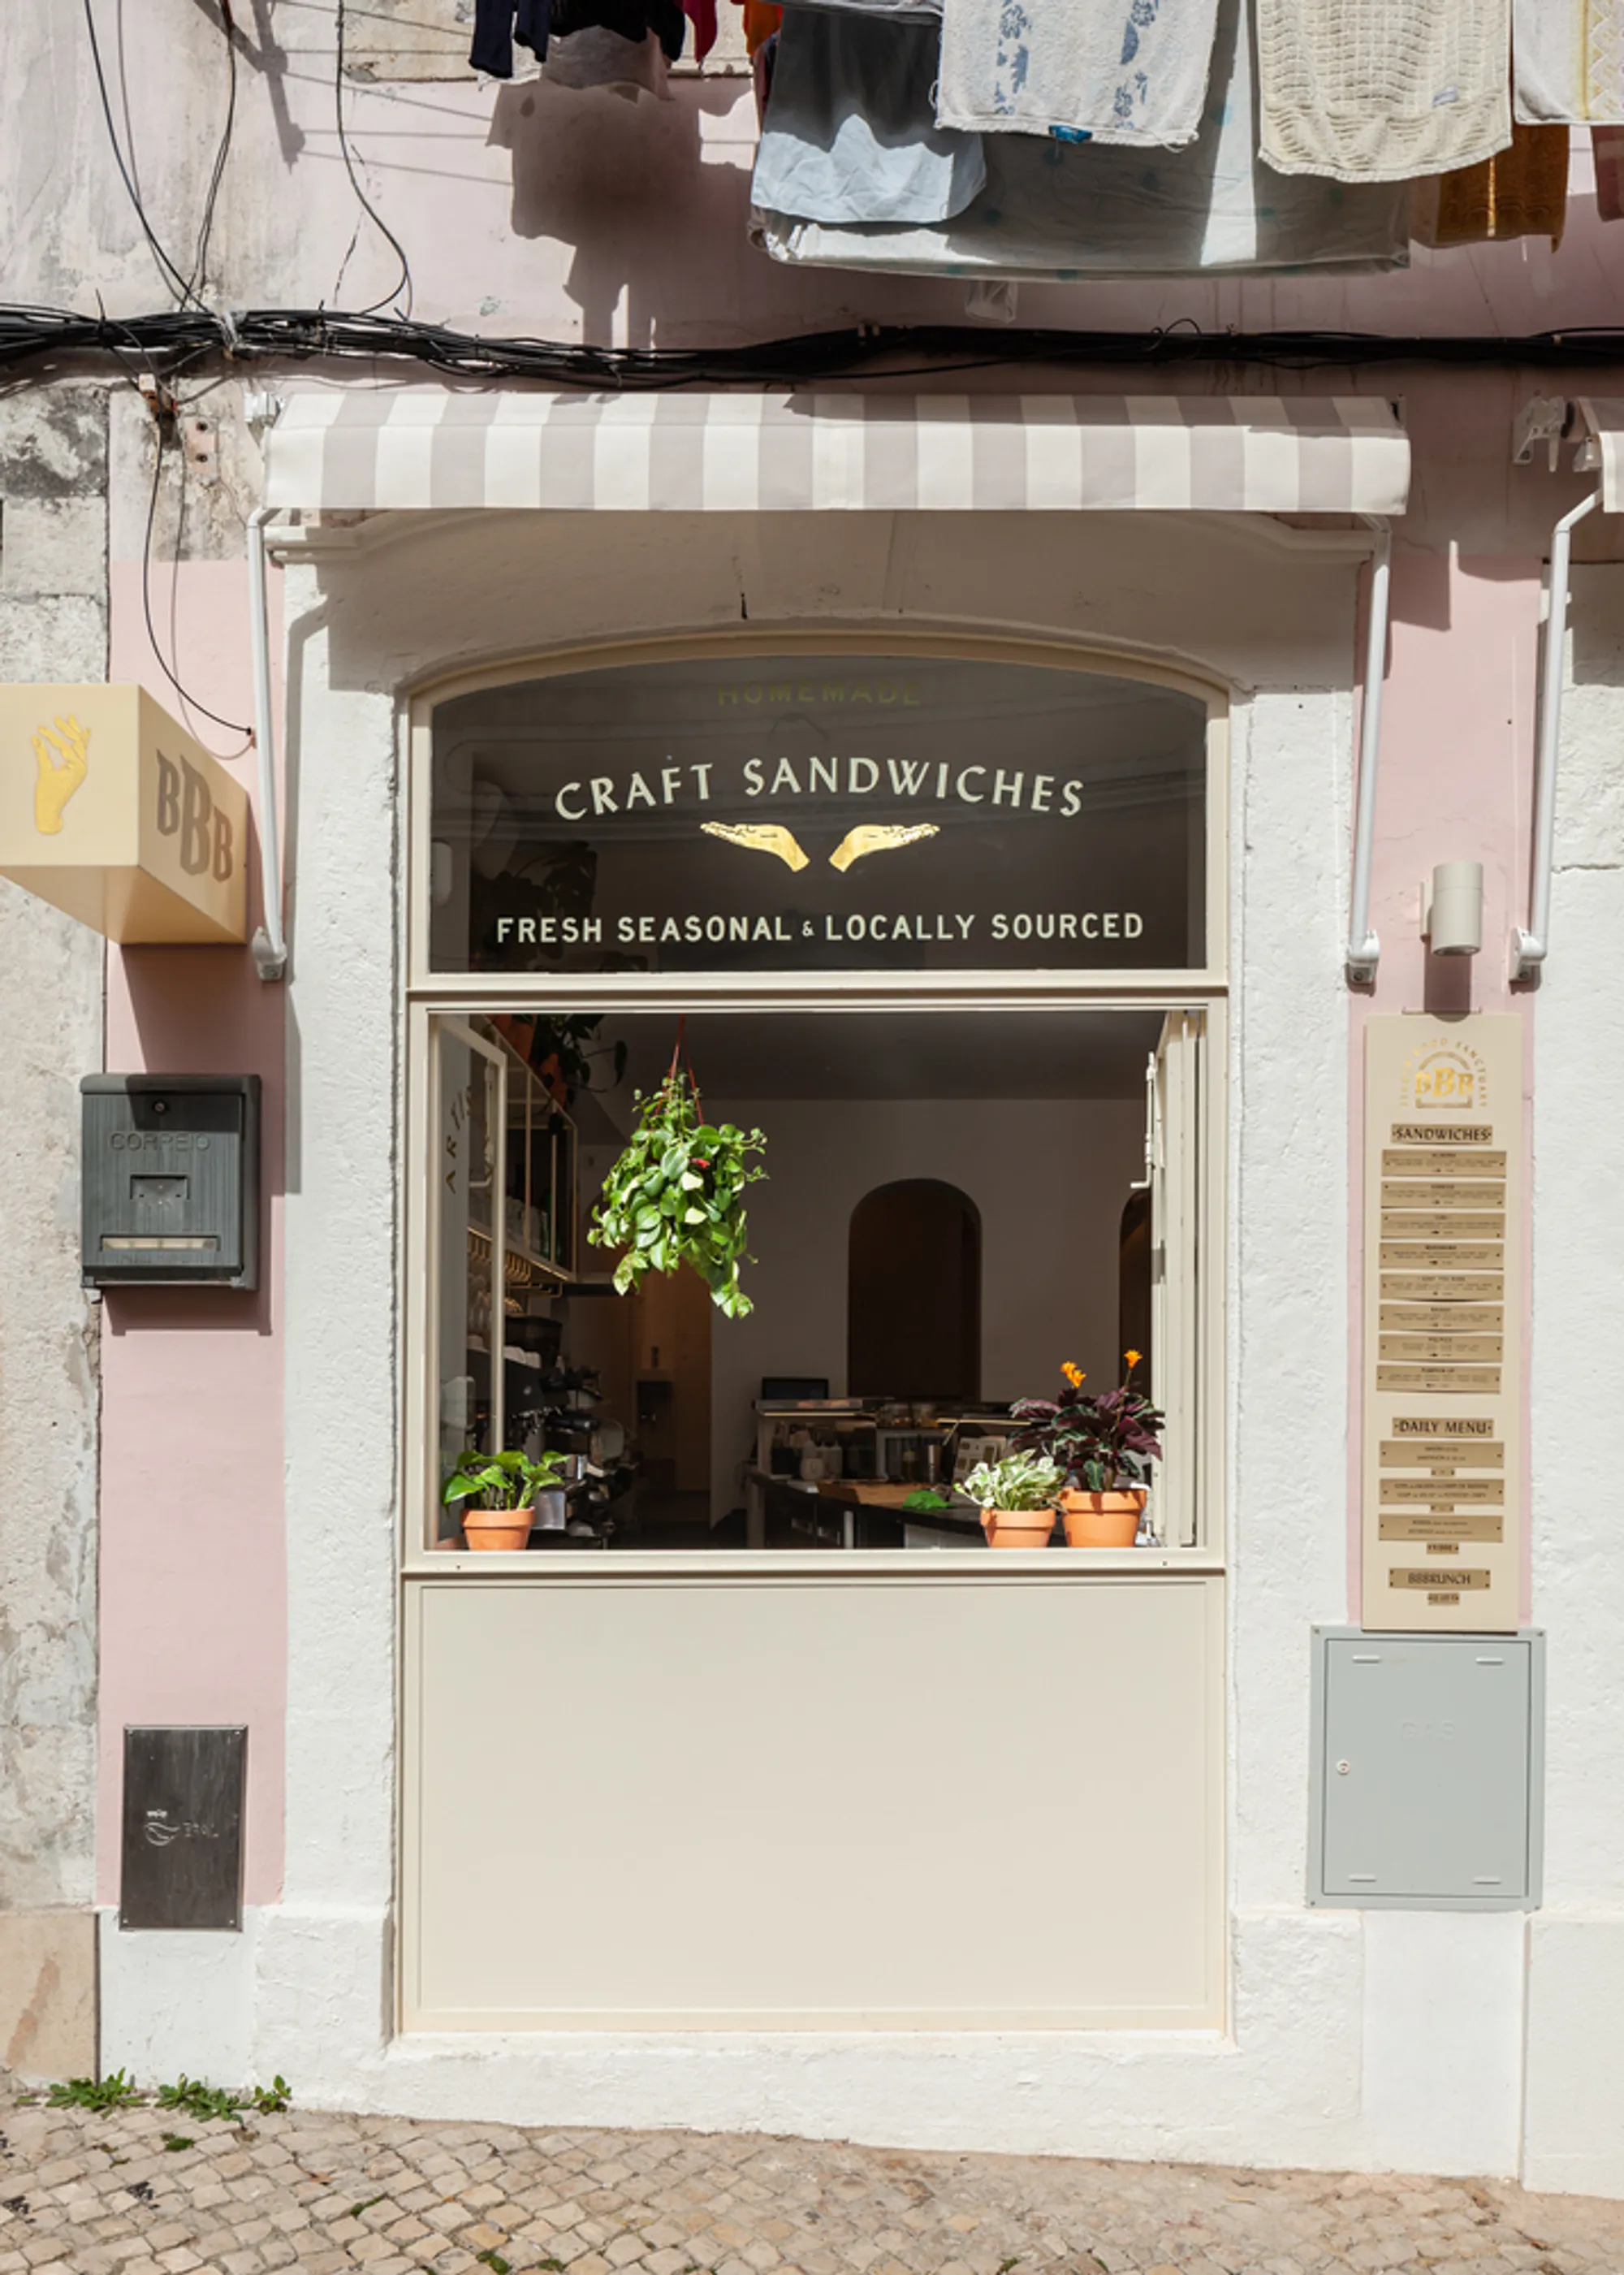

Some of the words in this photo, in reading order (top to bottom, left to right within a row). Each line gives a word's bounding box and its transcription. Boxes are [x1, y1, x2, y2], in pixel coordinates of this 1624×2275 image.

[717, 678, 922, 706] HOMEMADE
[555, 763, 713, 819] CRAFT
[743, 756, 1083, 817] SANDWICHES
[156, 748, 233, 882] BBB
[498, 917, 601, 942] FRESH
[618, 915, 791, 941] SEASONAL
[802, 920, 814, 936] &
[826, 915, 974, 940] LOCALLY
[991, 913, 1142, 939] SOURCED
[110, 1133, 209, 1152] CORREIO
[1396, 1127, 1488, 1140] SANDWICHES
[1400, 1420, 1438, 1433] DAILY
[1445, 1421, 1487, 1434] MENU
